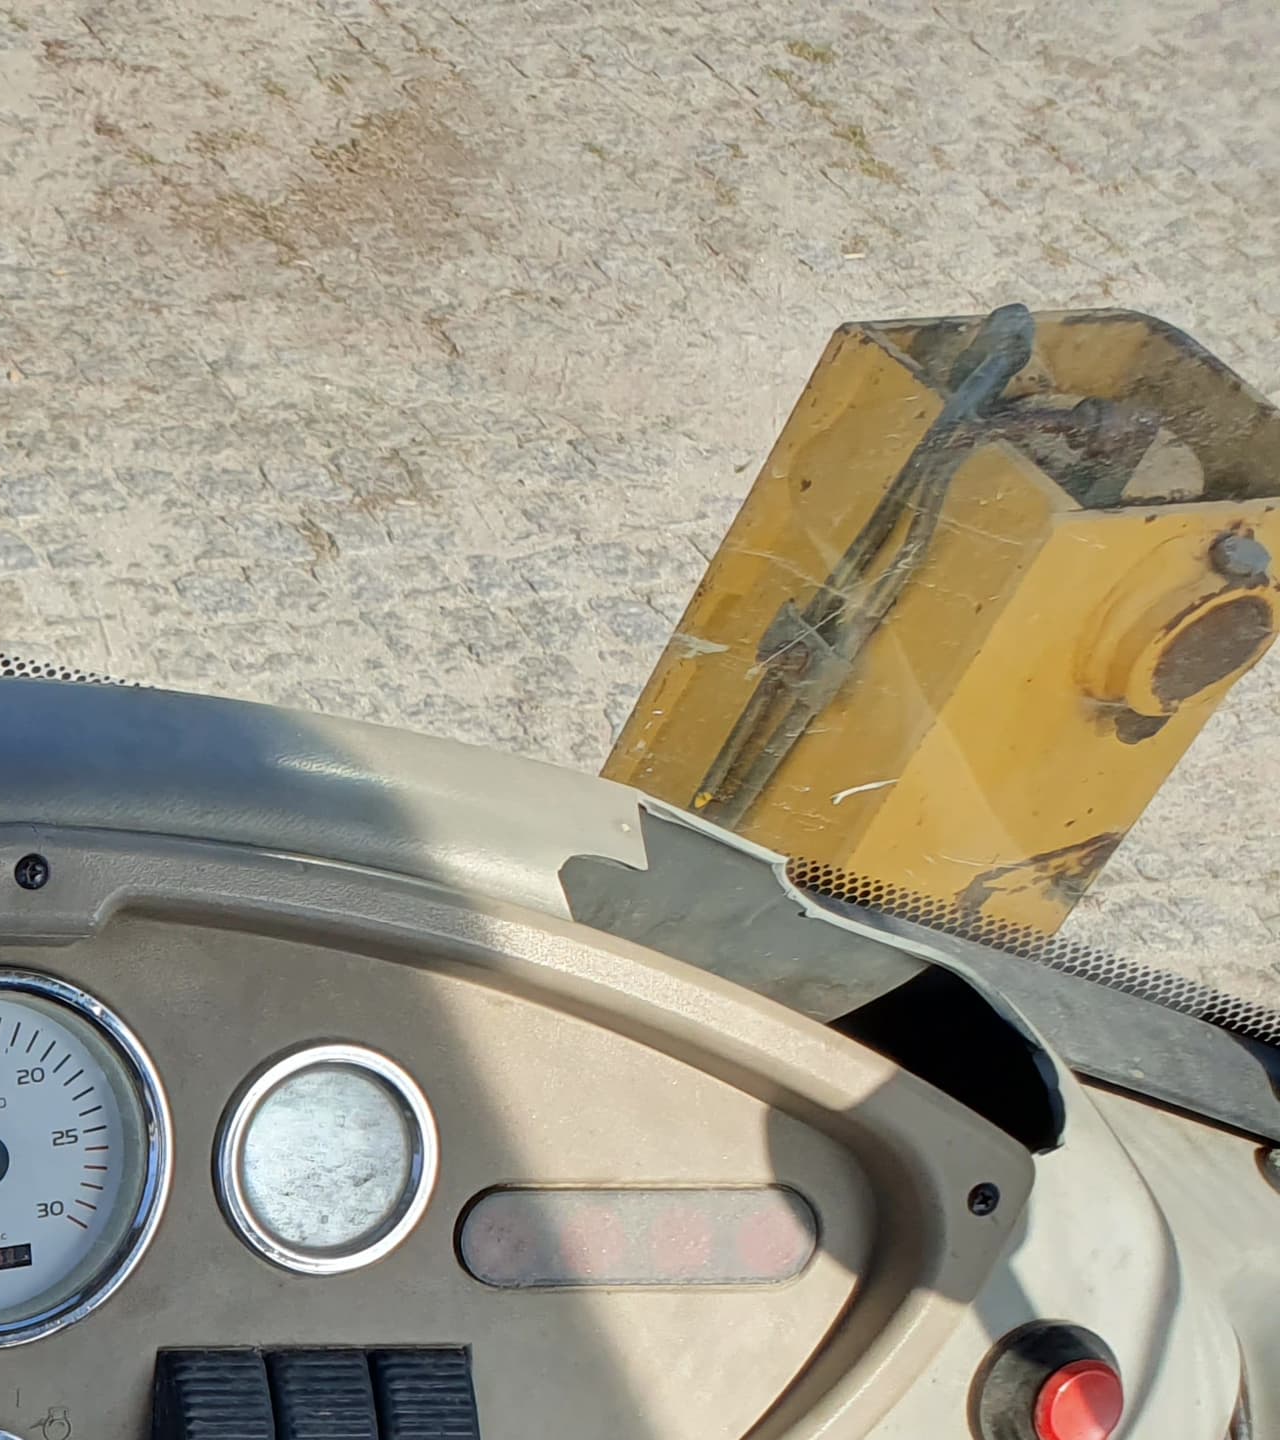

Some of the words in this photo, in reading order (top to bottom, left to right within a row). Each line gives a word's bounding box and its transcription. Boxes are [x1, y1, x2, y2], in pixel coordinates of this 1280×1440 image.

[17, 1067, 45, 1085] 20
[52, 1129, 79, 1146] 25
[37, 1201, 64, 1218] 30
